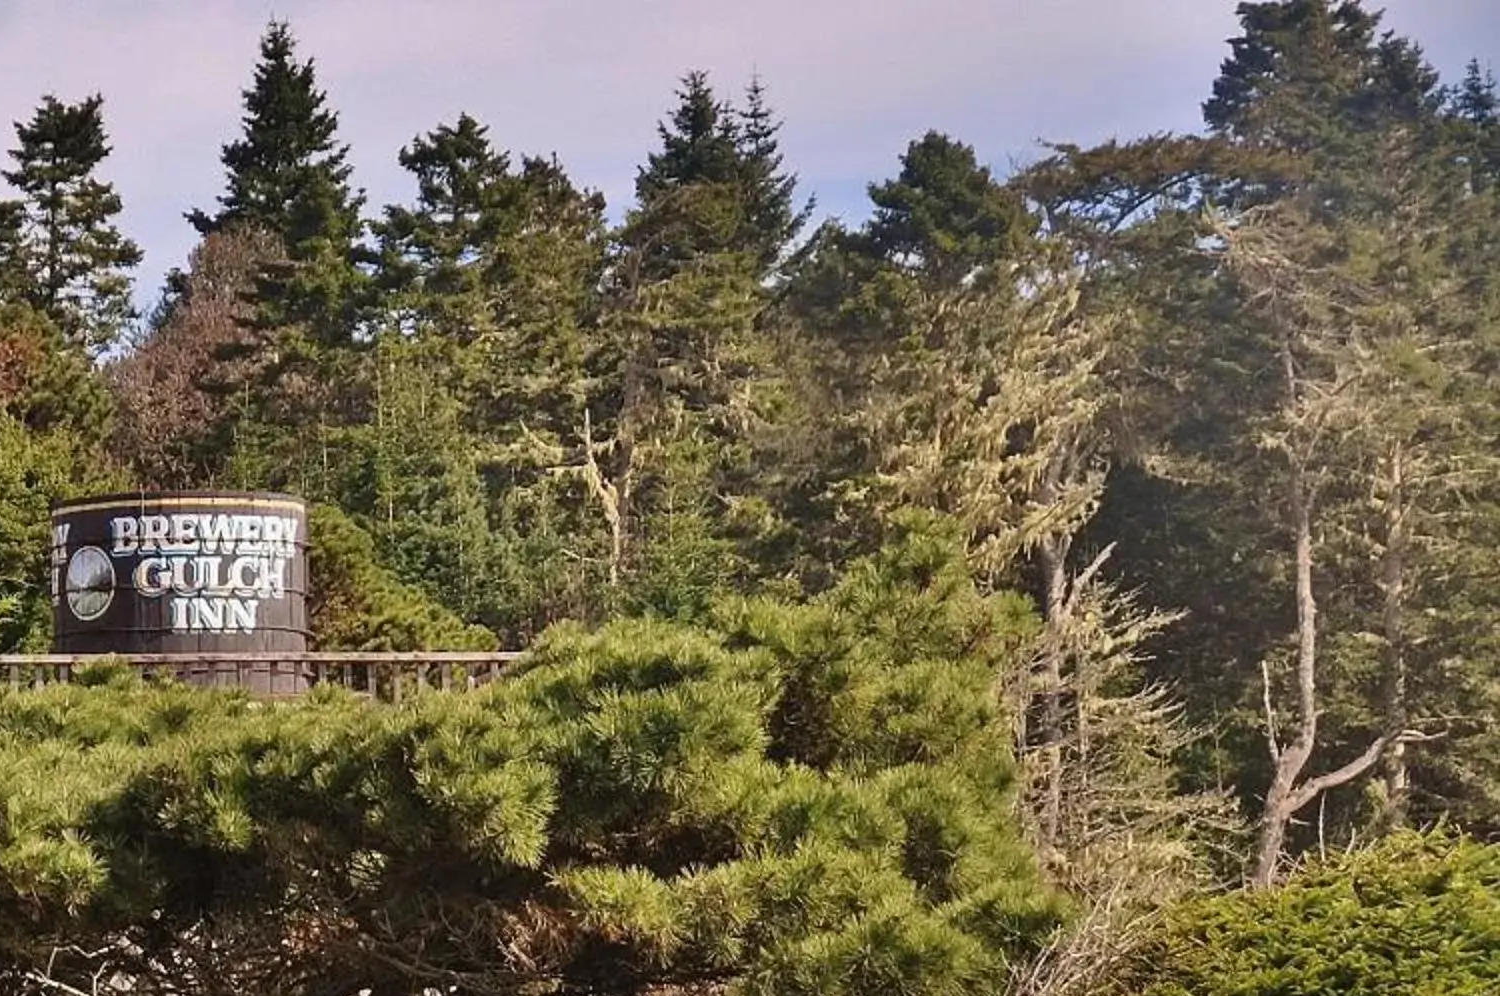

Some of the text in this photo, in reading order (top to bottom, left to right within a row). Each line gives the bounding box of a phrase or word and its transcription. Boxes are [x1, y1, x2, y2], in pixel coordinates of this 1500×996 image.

[110, 514, 297, 558] BREWERY
[133, 555, 285, 598] GULCH
[170, 597, 258, 634] INN
